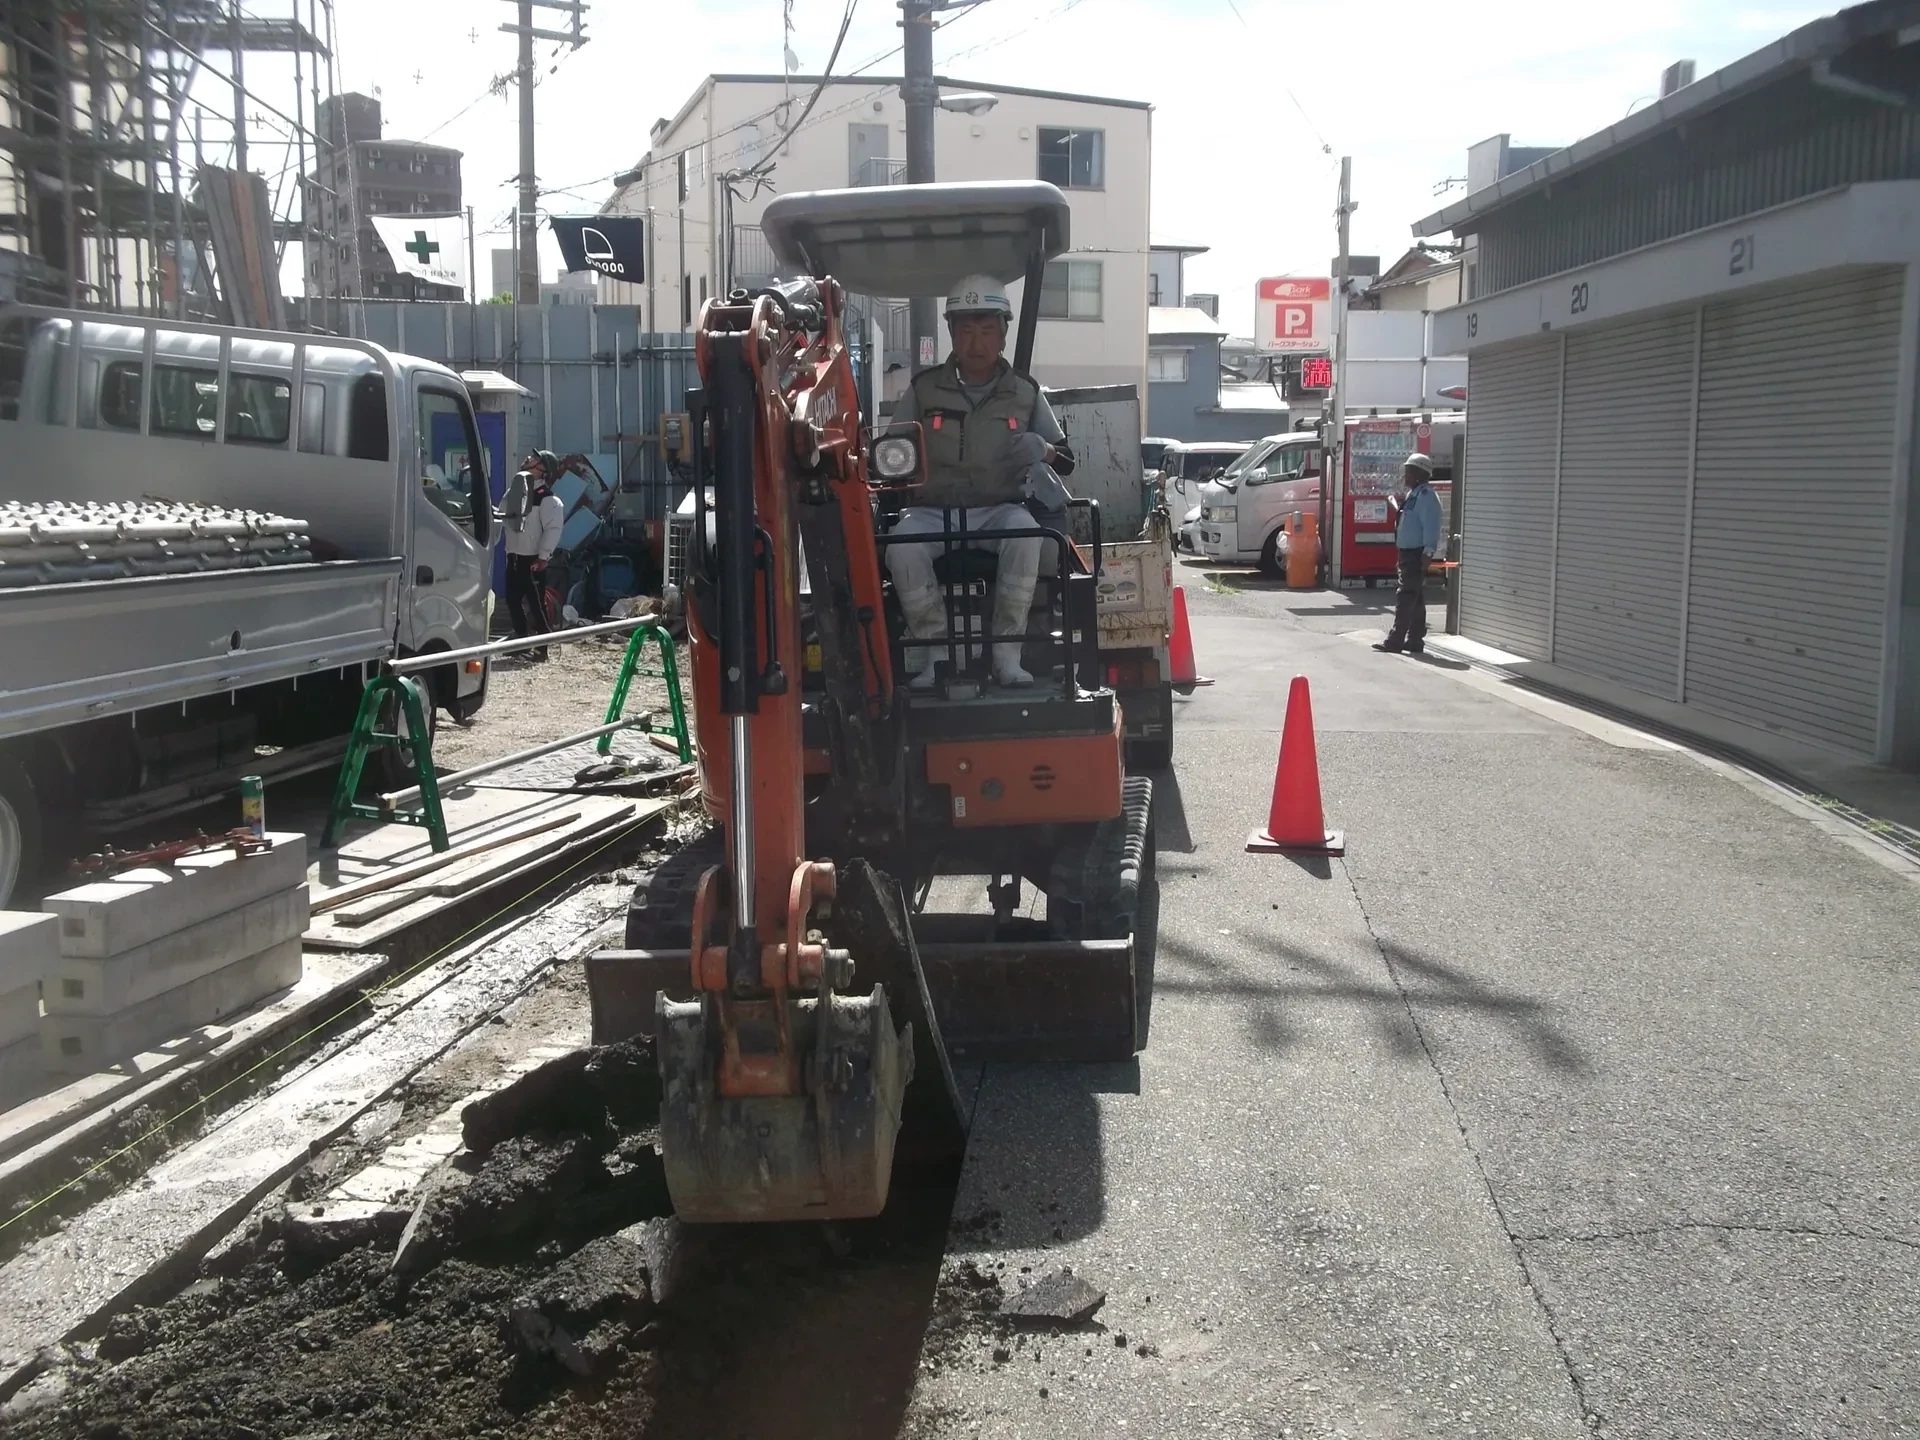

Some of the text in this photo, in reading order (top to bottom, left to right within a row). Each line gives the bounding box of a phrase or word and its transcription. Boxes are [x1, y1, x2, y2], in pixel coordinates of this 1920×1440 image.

[1729, 234, 1755, 276] 21
[1570, 282, 1589, 315] 20
[1284, 308, 1306, 335] P
[1466, 312, 1478, 338] 19
[1303, 358, 1331, 387] 満
[1124, 724, 1163, 737] LF
